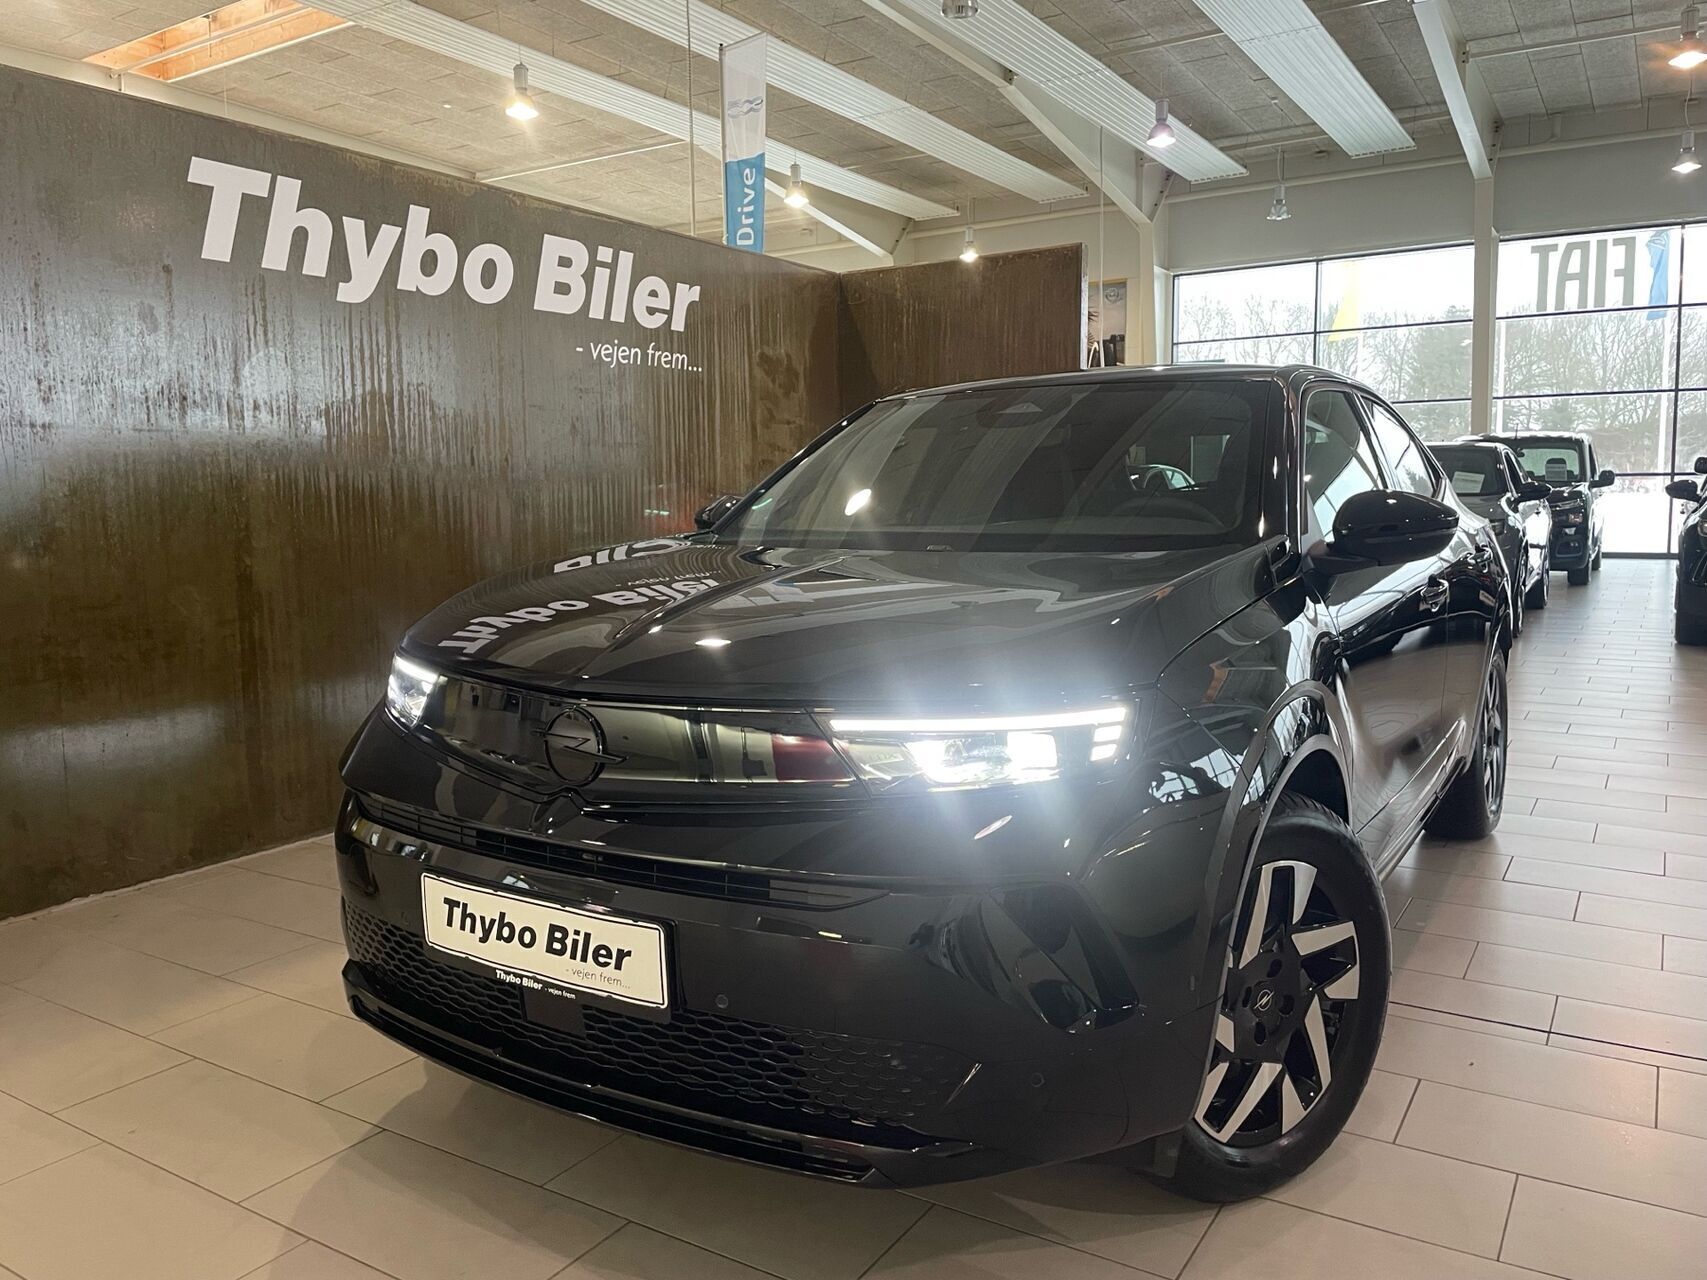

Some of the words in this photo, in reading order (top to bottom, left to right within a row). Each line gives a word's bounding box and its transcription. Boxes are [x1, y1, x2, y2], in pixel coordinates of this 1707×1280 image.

[737, 168, 755, 245] Drive
[187, 156, 514, 304] Thybo
[533, 234, 701, 332] Biler
[590, 341, 642, 374] vejen
[647, 343, 703, 373] frem...
[443, 896, 537, 949] Thybo
[545, 923, 632, 972] Biler
[495, 970, 521, 984] Thybo
[523, 977, 542, 990] Biler
[548, 987, 562, 996] vejen
[563, 990, 575, 999] frem
[572, 968, 597, 983] vejen
